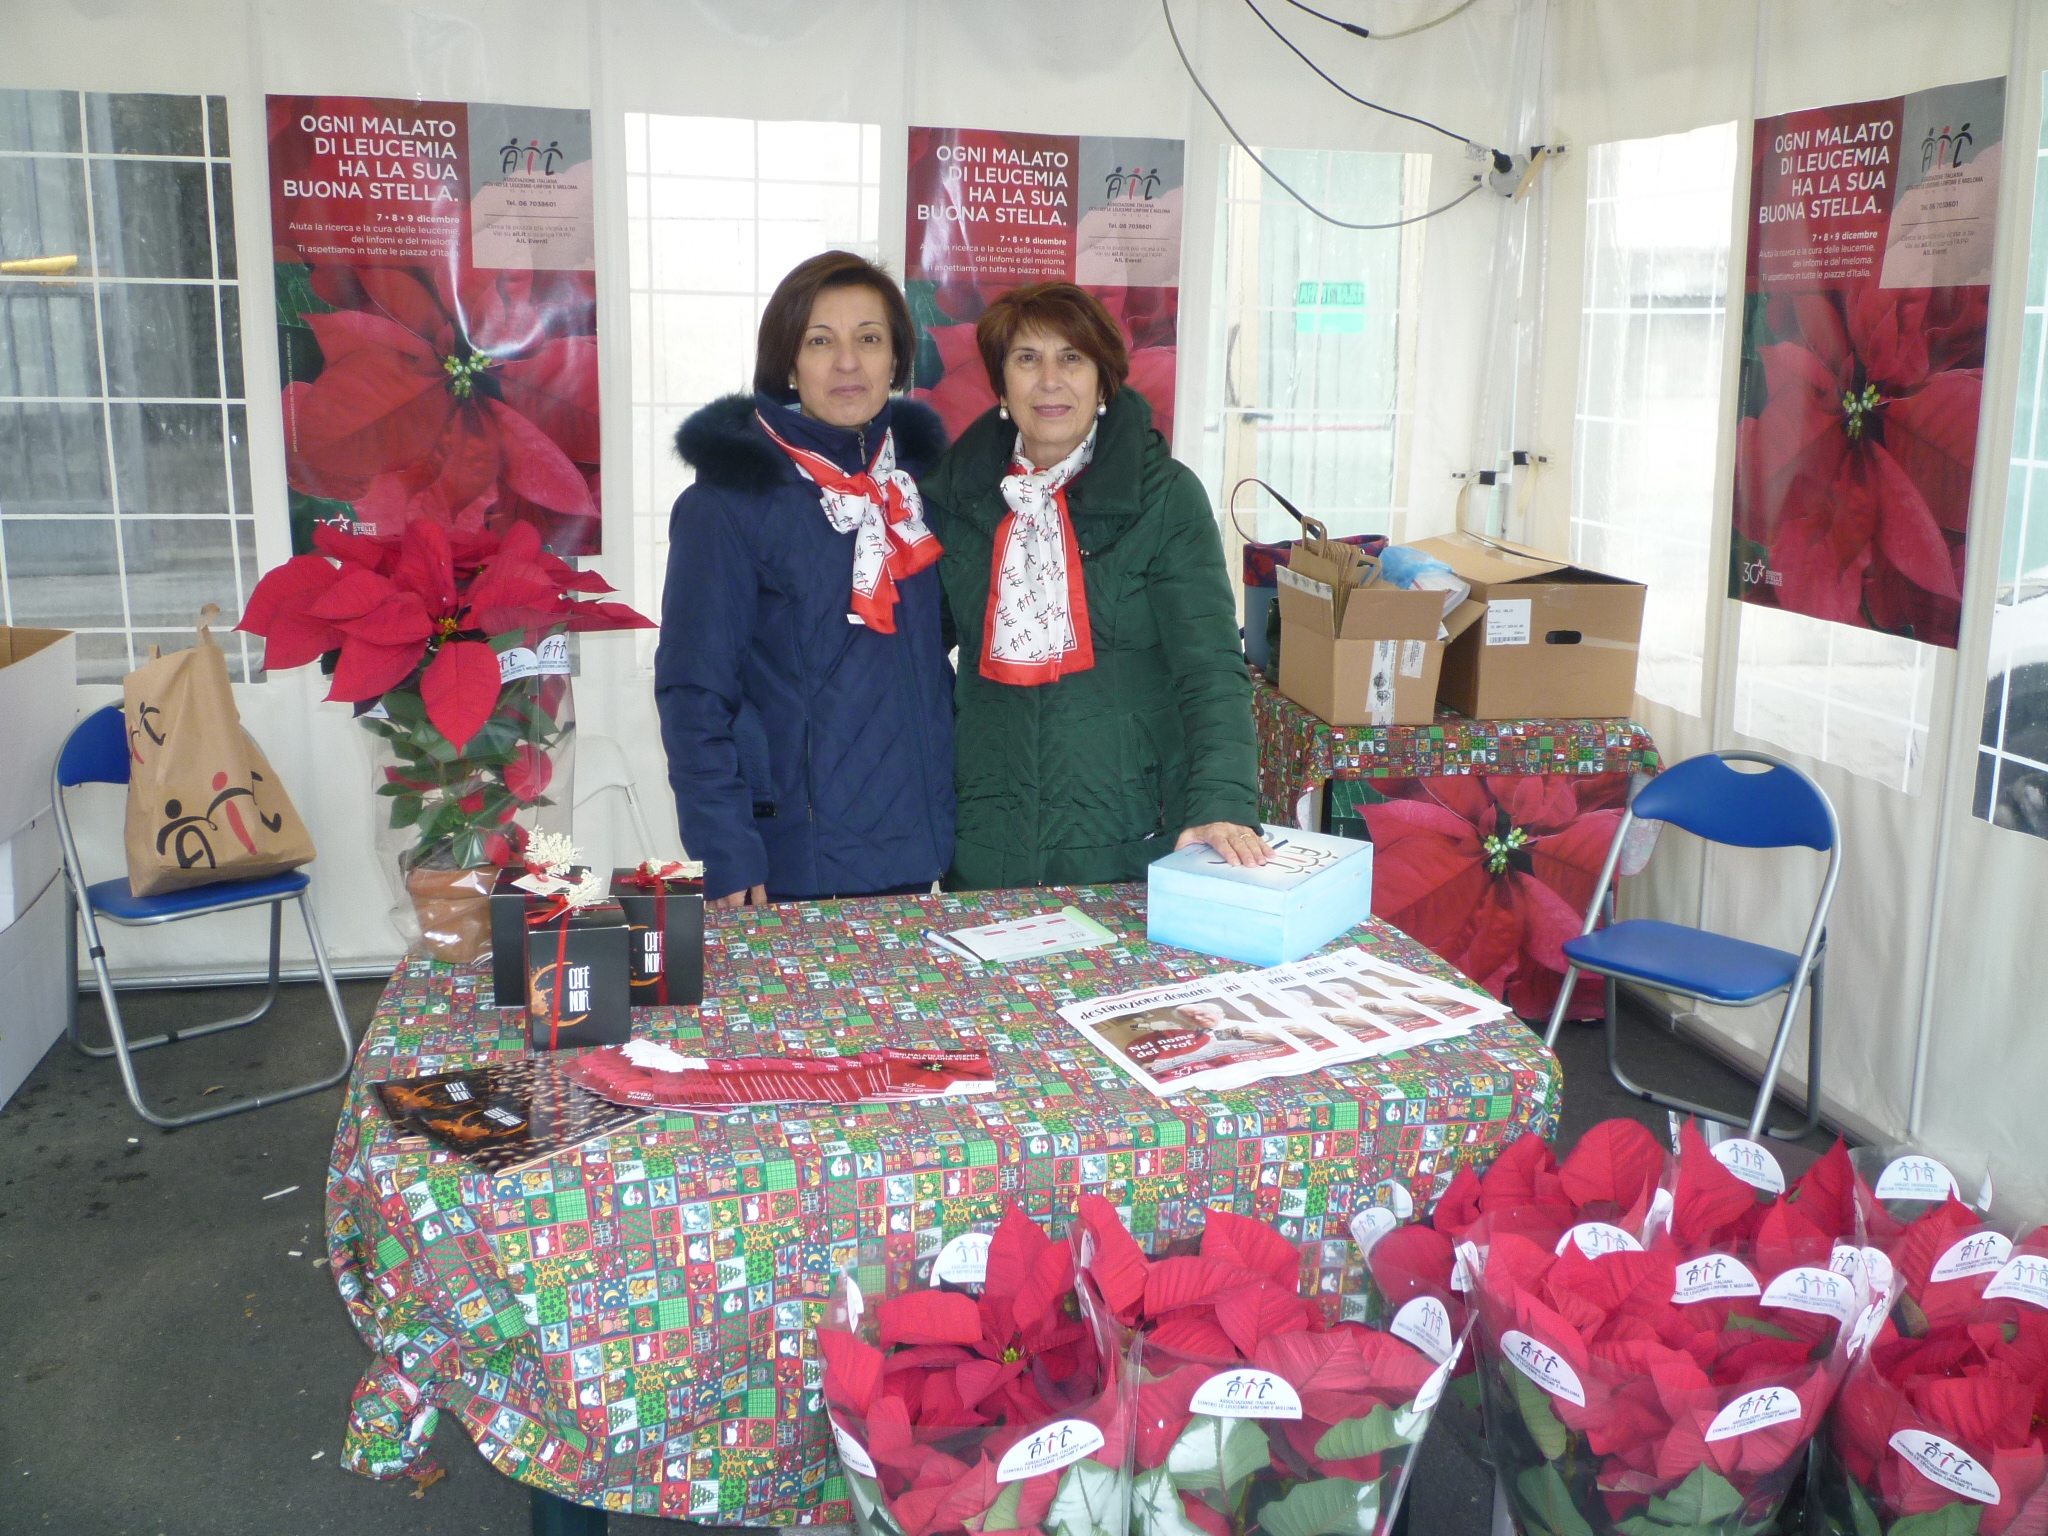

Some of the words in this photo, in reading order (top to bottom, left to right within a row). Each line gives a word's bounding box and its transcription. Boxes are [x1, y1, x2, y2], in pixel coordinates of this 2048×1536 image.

[300, 115, 354, 133] OGNI
[362, 117, 456, 137] MALATO
[1775, 130, 1810, 154] OGNI
[1815, 120, 1894, 148] MALATO
[315, 137, 336, 155] DI
[342, 138, 458, 159] LEUCEMIA
[936, 145, 986, 163] OGNI
[992, 147, 1069, 168] MALATO
[338, 160, 369, 178] HA
[376, 161, 405, 179] LA
[413, 162, 458, 181] SUA
[500, 143, 563, 176] AIL
[1780, 156, 1793, 176] DI
[1797, 145, 1890, 174] LEUCEMIA
[948, 165, 968, 182] DI
[974, 166, 1069, 188] LEUCEMIA
[1106, 171, 1161, 200] AIL
[1791, 177, 1814, 197] HA
[1819, 174, 1841, 195] LA
[1846, 170, 1886, 192] SUA
[283, 179, 363, 199] BUONA
[369, 181, 459, 202] STELLA.
[969, 186, 996, 203] HA
[1002, 188, 1026, 205] LA
[1031, 190, 1068, 207] SUA
[417, 214, 460, 224] dicembre
[917, 204, 990, 222] BUONA
[995, 207, 1067, 226] STELLA.
[1759, 201, 1806, 224] BUONA
[1810, 195, 1882, 219] STELLA.
[288, 221, 313, 231] Aiuta
[314, 222, 323, 231] la
[325, 223, 354, 232] ricerca
[363, 223, 371, 232] la
[373, 226, 393, 234] cura
[395, 225, 416, 234] delle
[1841, 230, 1878, 240] dicembre
[297, 244, 305, 253] Ti
[307, 246, 355, 255] aspettiamo
[357, 247, 365, 255] in
[366, 247, 388, 256] tutte
[389, 247, 398, 256] le
[400, 248, 428, 258] piazze
[351, 235, 365, 243] dei
[366, 235, 396, 244] linfomi
[405, 236, 419, 245] del
[951, 244, 979, 252] ricerca
[987, 244, 995, 252] la
[996, 246, 1013, 254] cura
[1014, 246, 1032, 254] delle
[1032, 236, 1067, 246] dicembre
[1808, 247, 1822, 256] cura
[1823, 245, 1840, 254] delle
[934, 265, 979, 273] aspettiamo
[980, 265, 988, 273] in
[989, 265, 1008, 273] tutte
[1008, 266, 1016, 274] le
[1017, 266, 1040, 276] piazze
[1041, 267, 1067, 276] d'Italia.
[975, 255, 988, 263] dei
[989, 255, 1015, 264] linfomi
[1022, 256, 1034, 265] del
[1034, 257, 1066, 266] mieloma.
[1829, 258, 1841, 266] del
[1841, 257, 1874, 265] mieloma.
[1816, 271, 1823, 279] le
[1823, 269, 1846, 280] piazze
[644, 952, 665, 974] NOIR
[568, 965, 591, 990] CAFÉ
[569, 989, 591, 1013] NOIR
[1080, 996, 1161, 1021] destinazione
[1163, 986, 1213, 1002] domani
[1127, 1041, 1155, 1054] Nel
[1157, 1032, 1196, 1047] nome
[1136, 1050, 1159, 1060] del
[1162, 1040, 1197, 1052] Prof.
[1227, 1379, 1273, 1399] AIL
[1197, 1400, 1217, 1408] CONTRO
[1220, 1398, 1254, 1406] ASSOCIAZIONE
[1739, 1393, 1778, 1418] AIL
[1029, 1428, 1071, 1459] AIL
[1924, 1444, 1971, 1475] AIL
